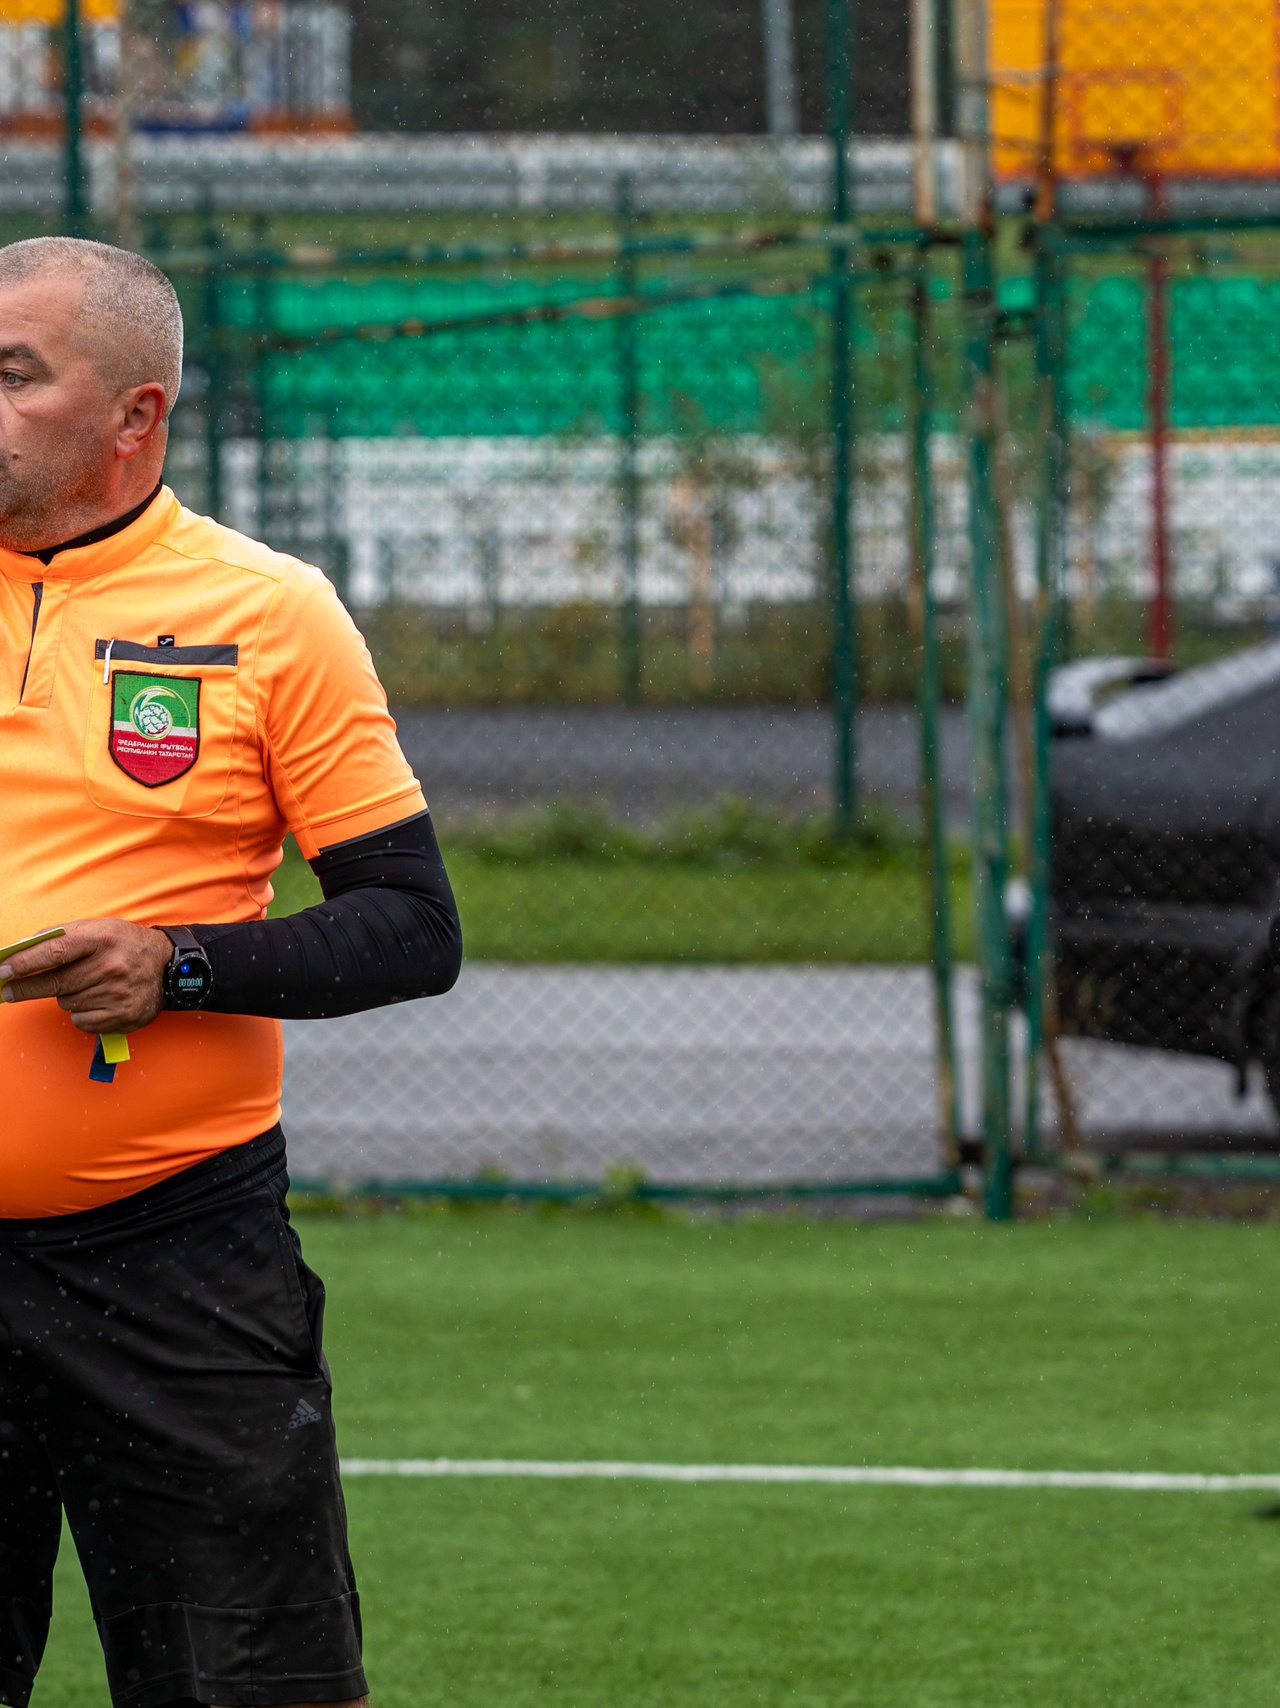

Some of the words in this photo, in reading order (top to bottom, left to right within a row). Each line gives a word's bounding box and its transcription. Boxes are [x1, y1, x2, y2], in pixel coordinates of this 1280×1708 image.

[118, 739, 158, 749] ФЕДЕРАЦИЯ
[160, 743, 193, 751] ФУТБОЛА
[116, 746, 157, 756] РЕСПУБЛИКИ
[158, 750, 194, 758] ТАТАРСТАН
